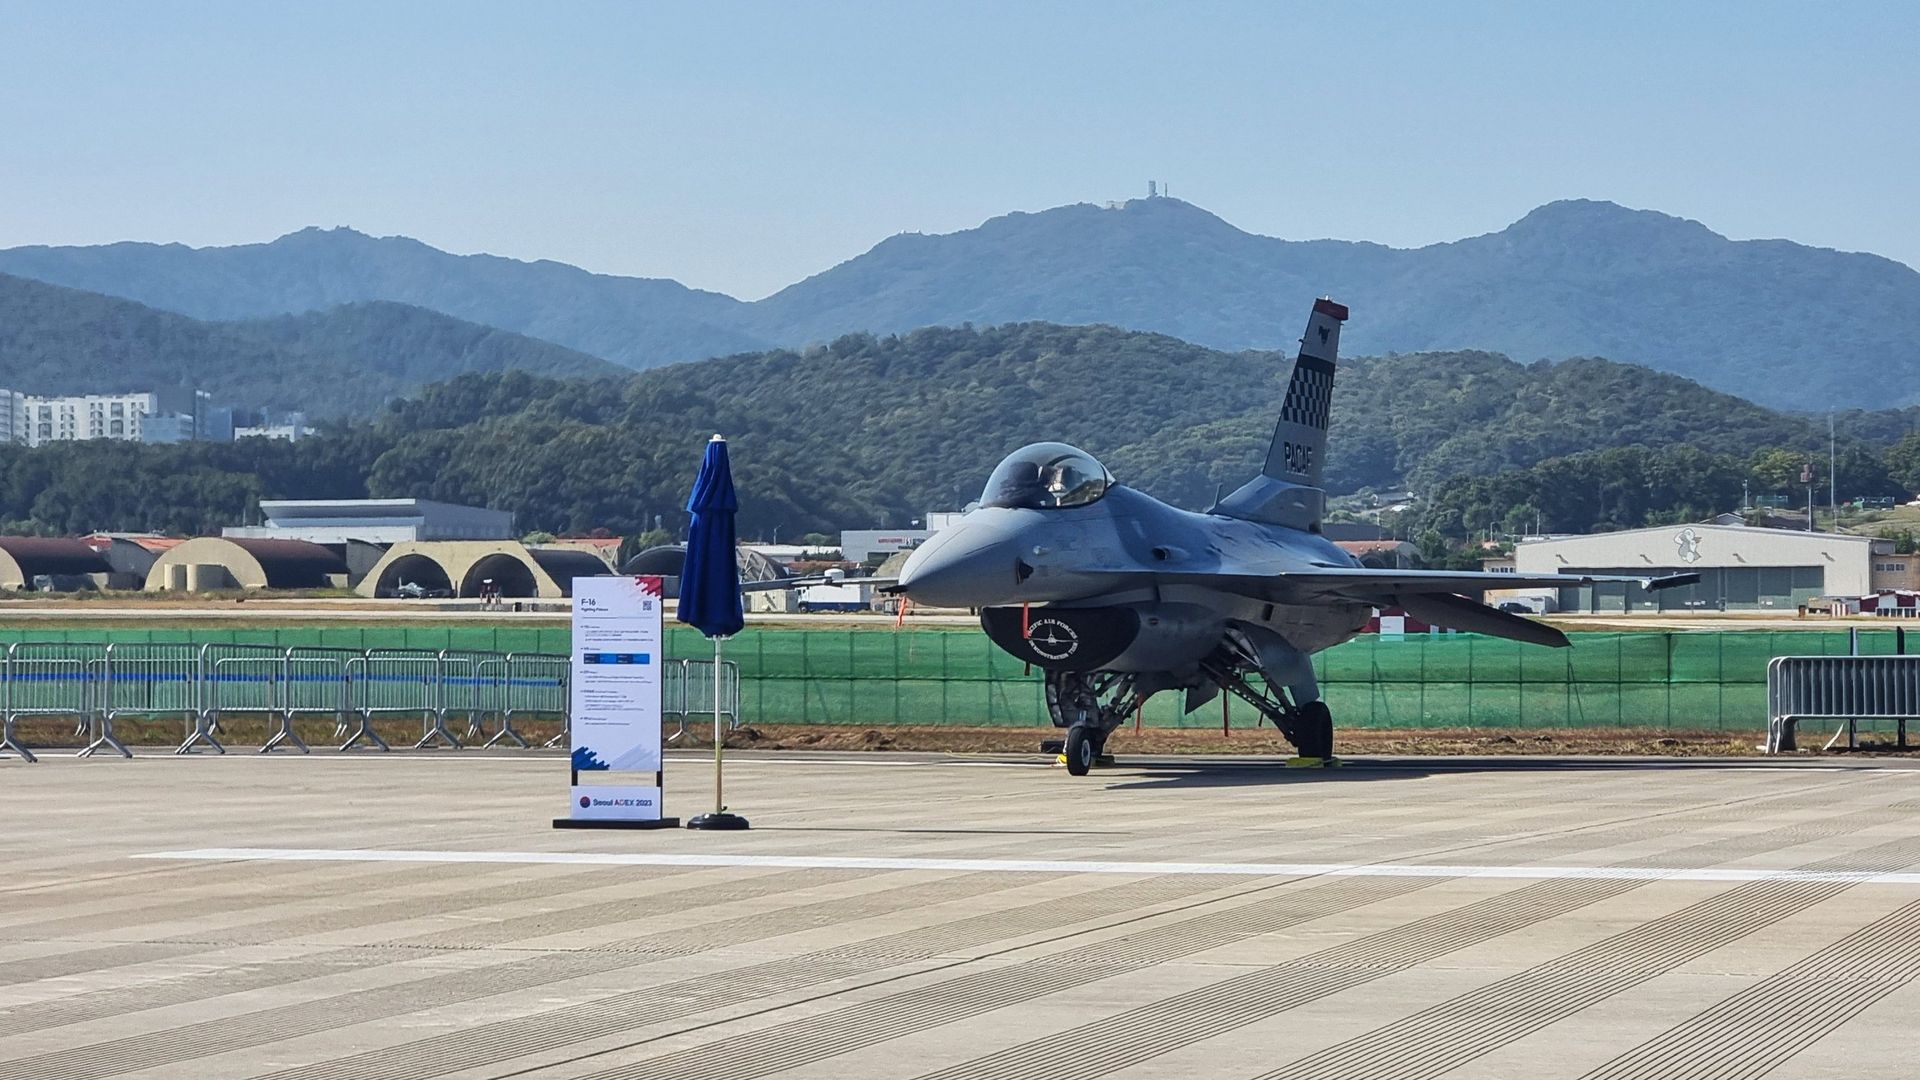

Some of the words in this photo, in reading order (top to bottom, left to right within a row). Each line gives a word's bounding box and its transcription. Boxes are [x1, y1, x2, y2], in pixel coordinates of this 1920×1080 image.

[1284, 441, 1312, 474] PACAF
[581, 598, 597, 606] F-16
[1056, 620, 1078, 639] FORCES
[593, 798, 613, 806] Seoul
[614, 799, 634, 807] ADEX
[635, 799, 653, 807] 2023
